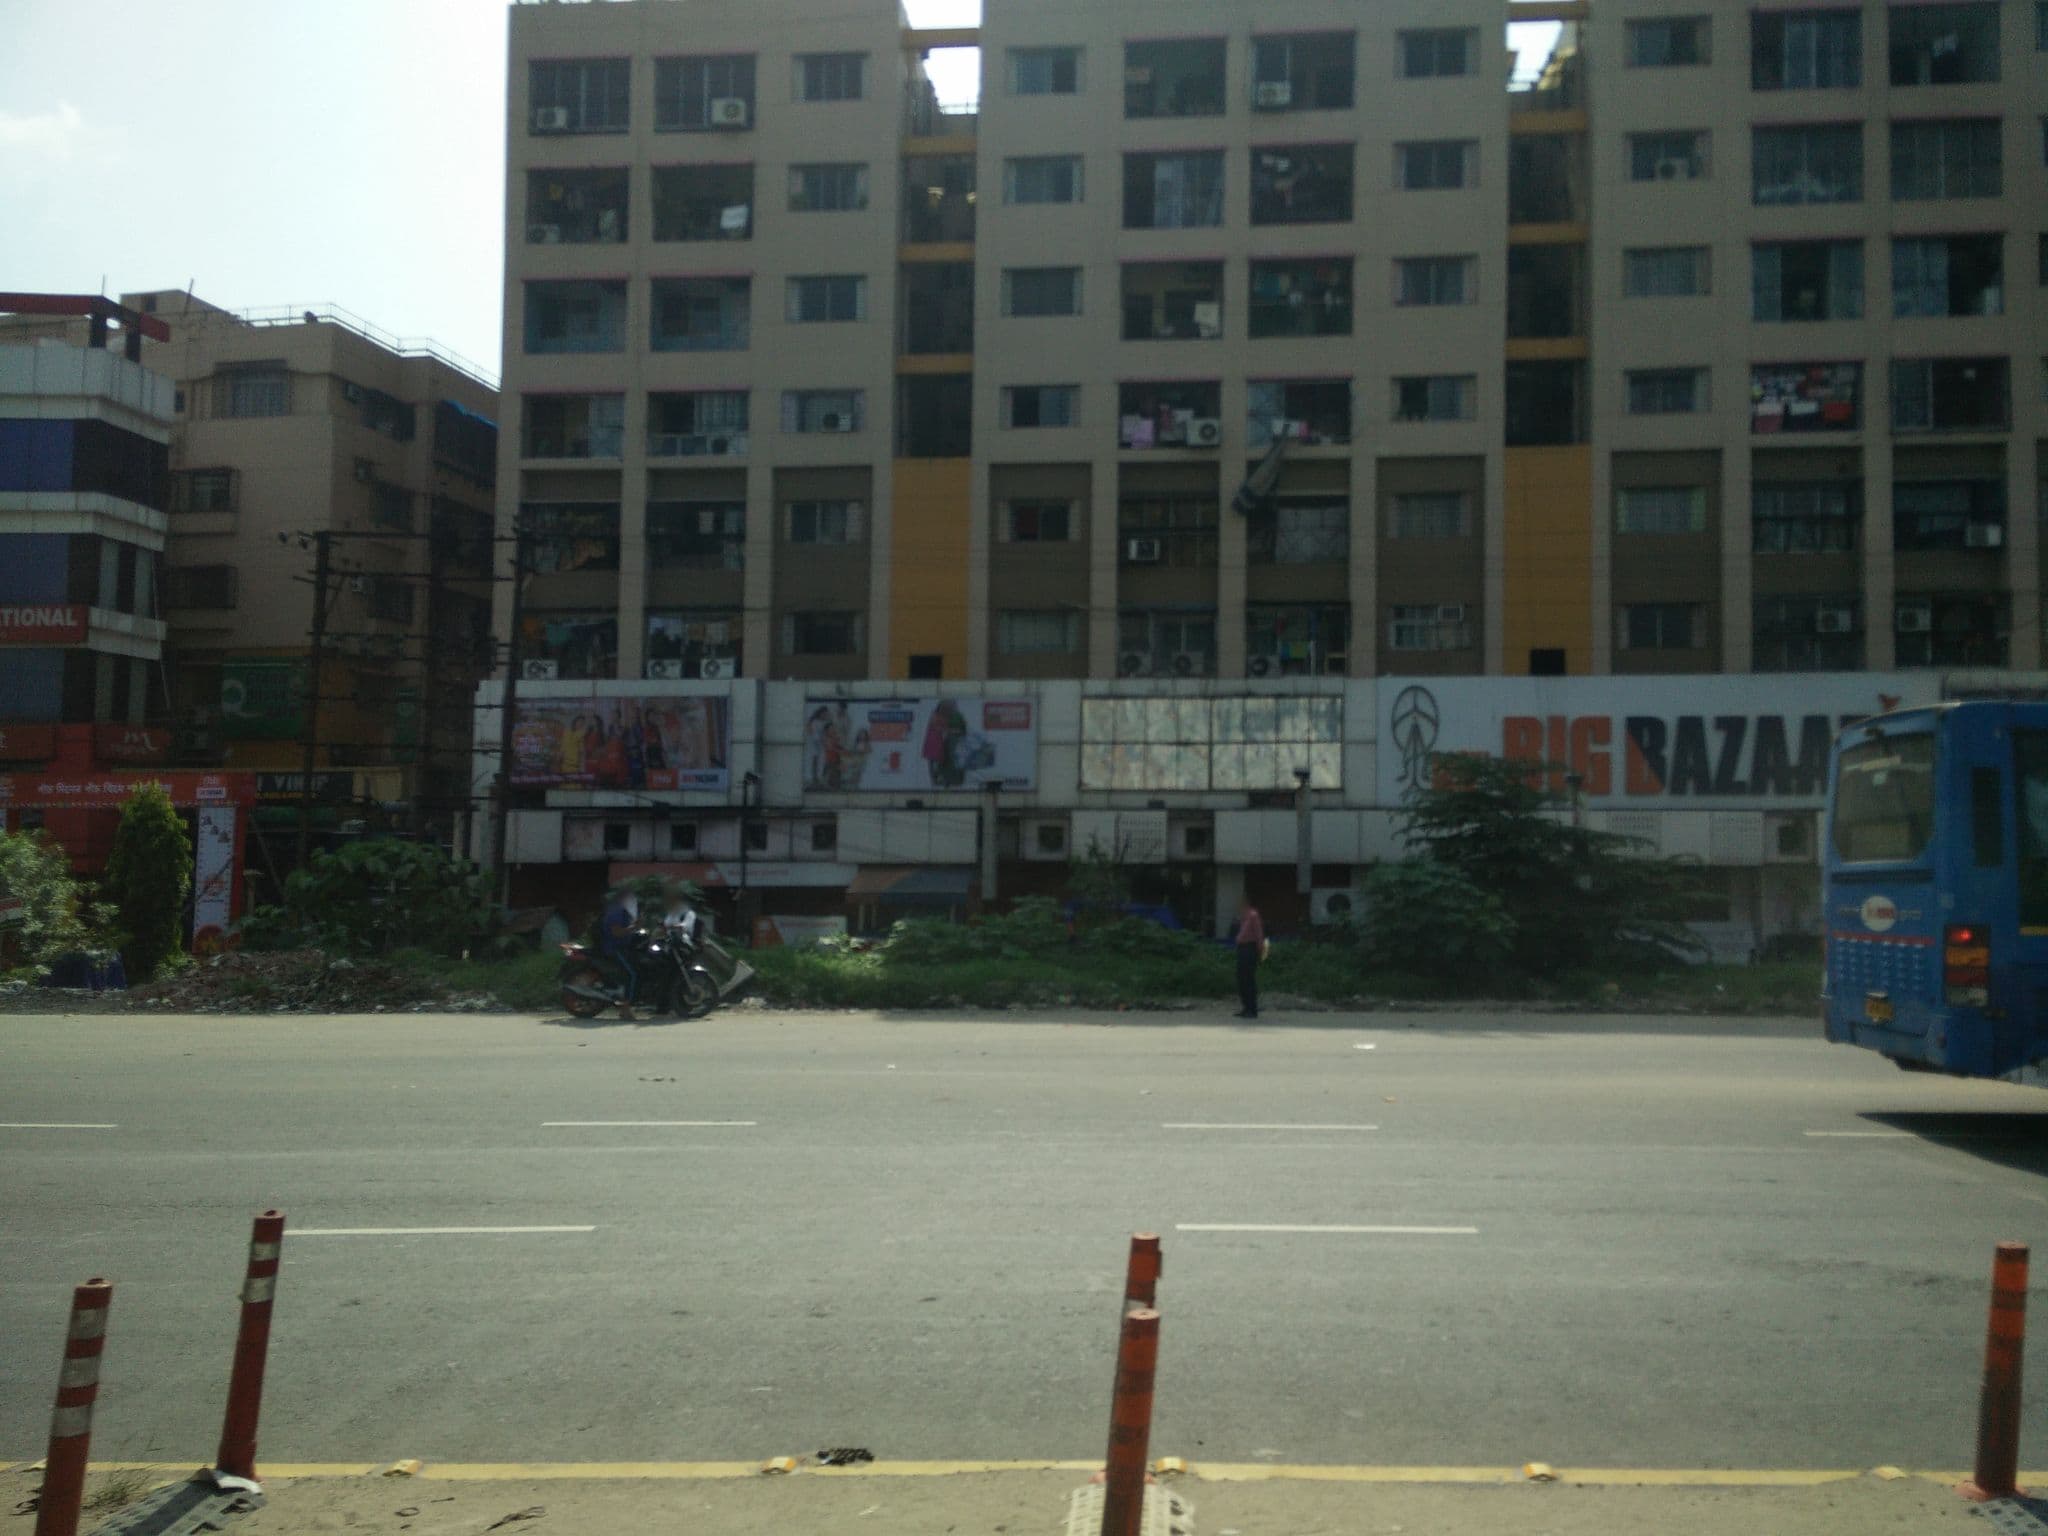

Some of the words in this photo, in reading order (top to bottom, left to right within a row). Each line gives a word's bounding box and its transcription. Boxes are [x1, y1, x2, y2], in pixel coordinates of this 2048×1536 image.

[0, 607, 78, 627] TIONAL
[1504, 716, 1611, 795] BIG
[1625, 715, 1866, 795] BAZAA
